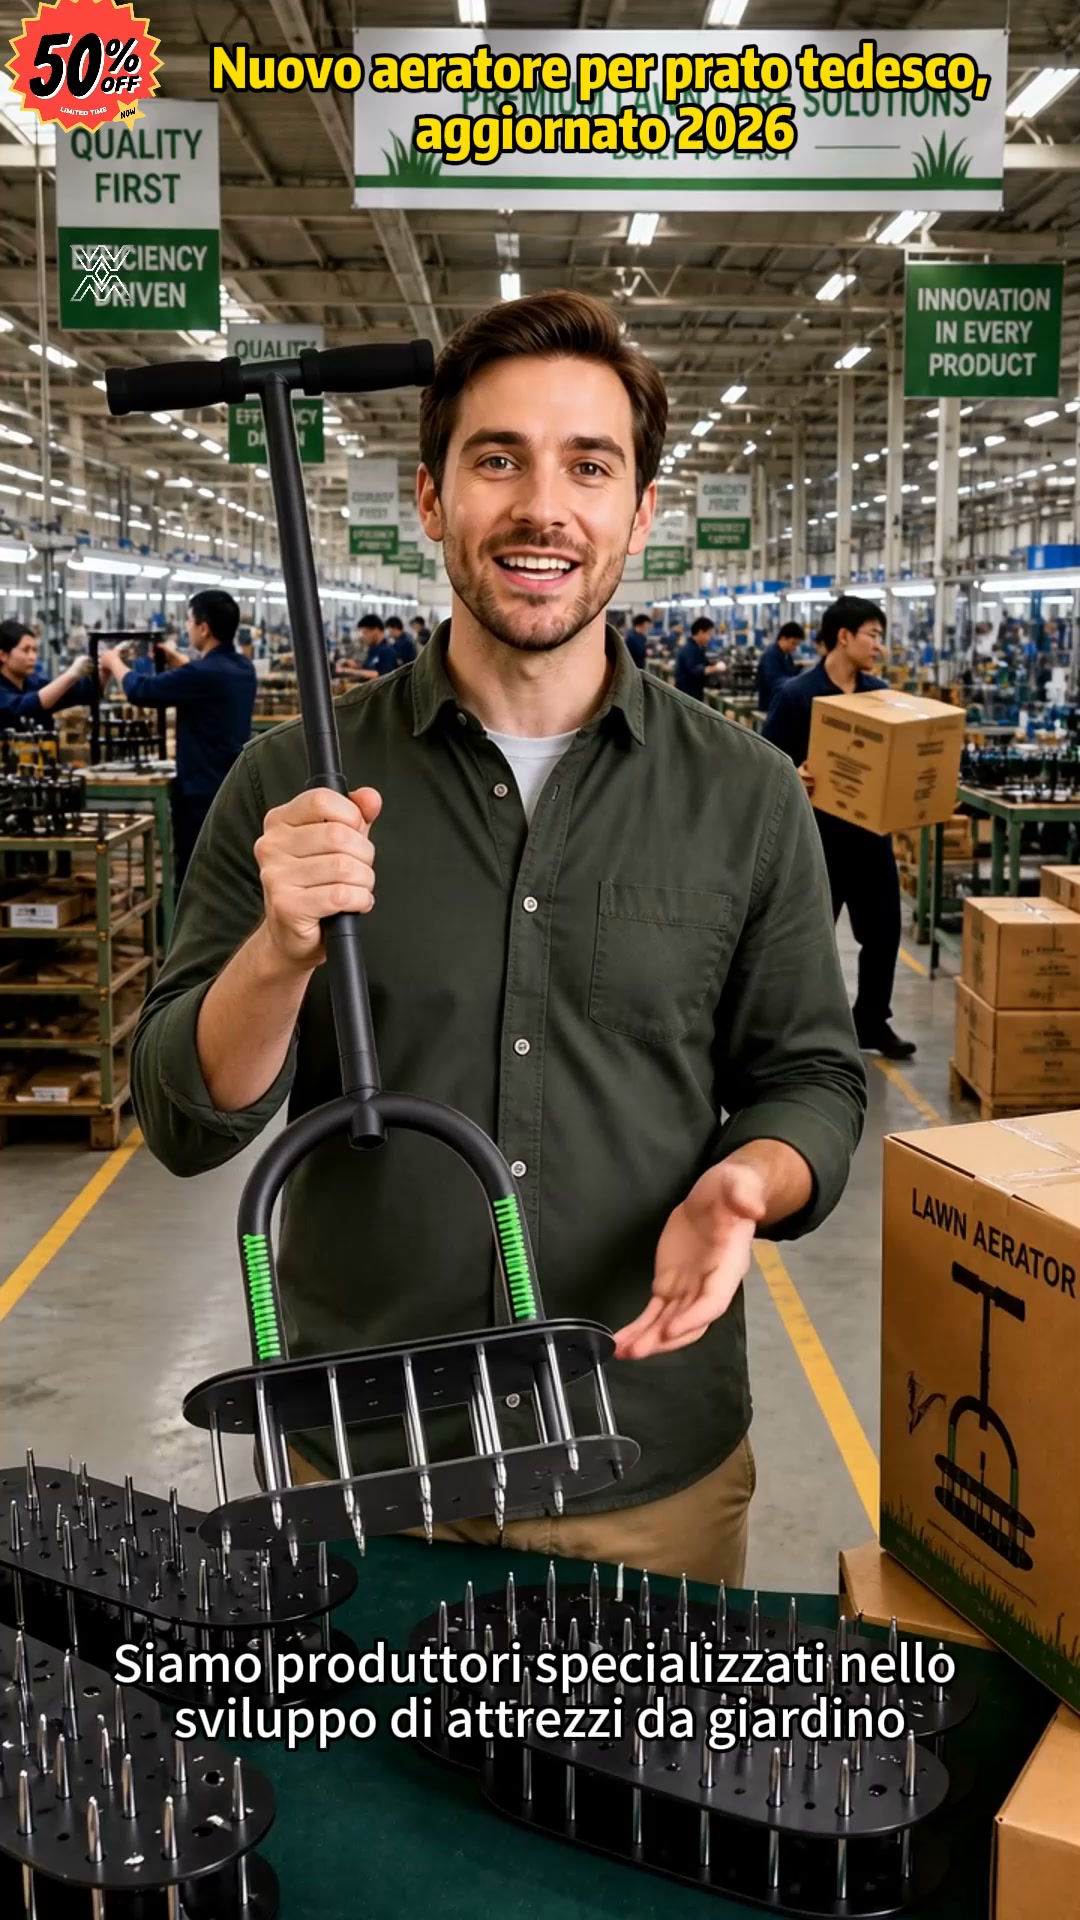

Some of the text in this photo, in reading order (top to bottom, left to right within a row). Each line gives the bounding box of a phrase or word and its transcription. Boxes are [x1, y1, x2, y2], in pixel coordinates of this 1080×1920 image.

[70, 129, 203, 162] QUALITY
[95, 173, 181, 204] FIRST
[917, 287, 1051, 312] INNOVATION
[935, 320, 1033, 344] IN EVERY
[929, 353, 1037, 377] PRODUCT
[912, 1187, 1077, 1299] LAWN AERATOR
